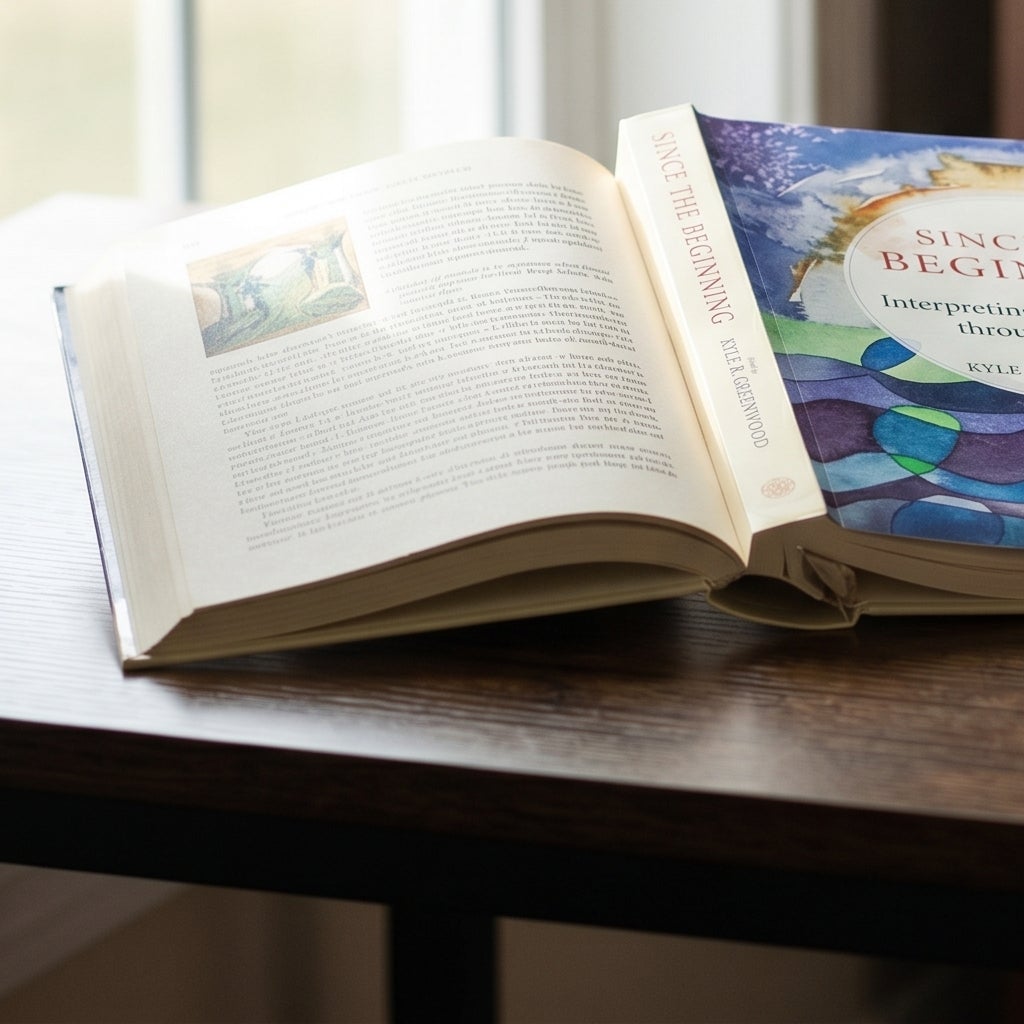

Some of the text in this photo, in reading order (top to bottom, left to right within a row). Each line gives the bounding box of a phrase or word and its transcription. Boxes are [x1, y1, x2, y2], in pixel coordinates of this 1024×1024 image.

[652, 130, 735, 325] SINCE THE BEGINNING
[966, 362, 1022, 375] KYLE
